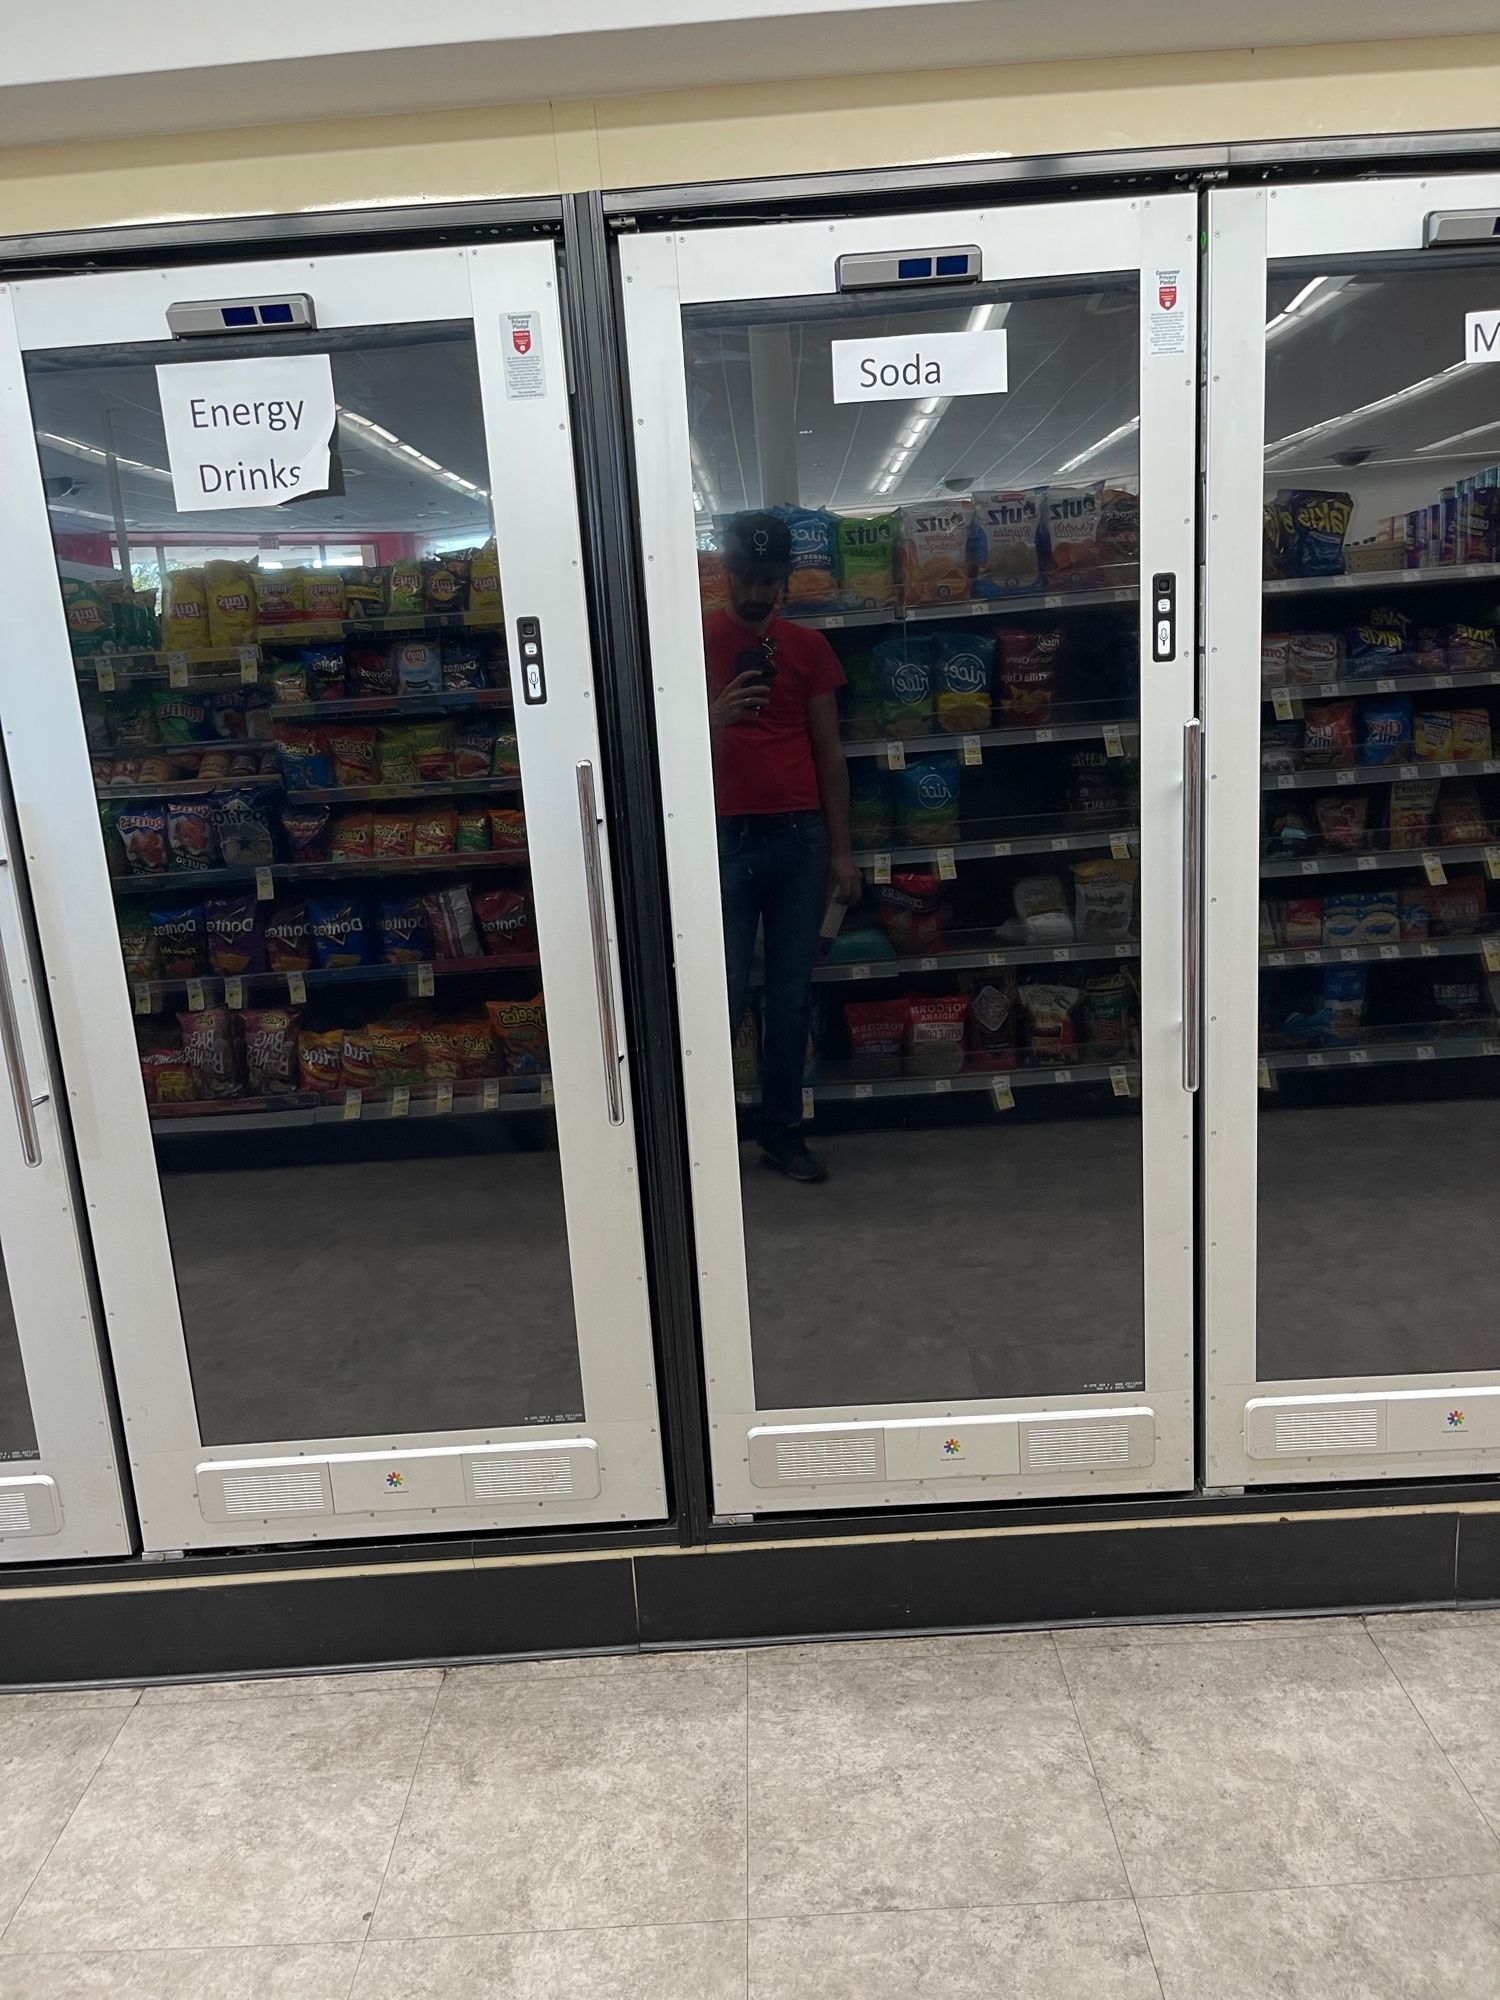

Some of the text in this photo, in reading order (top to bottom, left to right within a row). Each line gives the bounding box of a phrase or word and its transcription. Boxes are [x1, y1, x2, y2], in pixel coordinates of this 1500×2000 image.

[858, 354, 942, 389] Soda
[189, 397, 305, 433] Energy
[199, 457, 302, 495] Drinks
